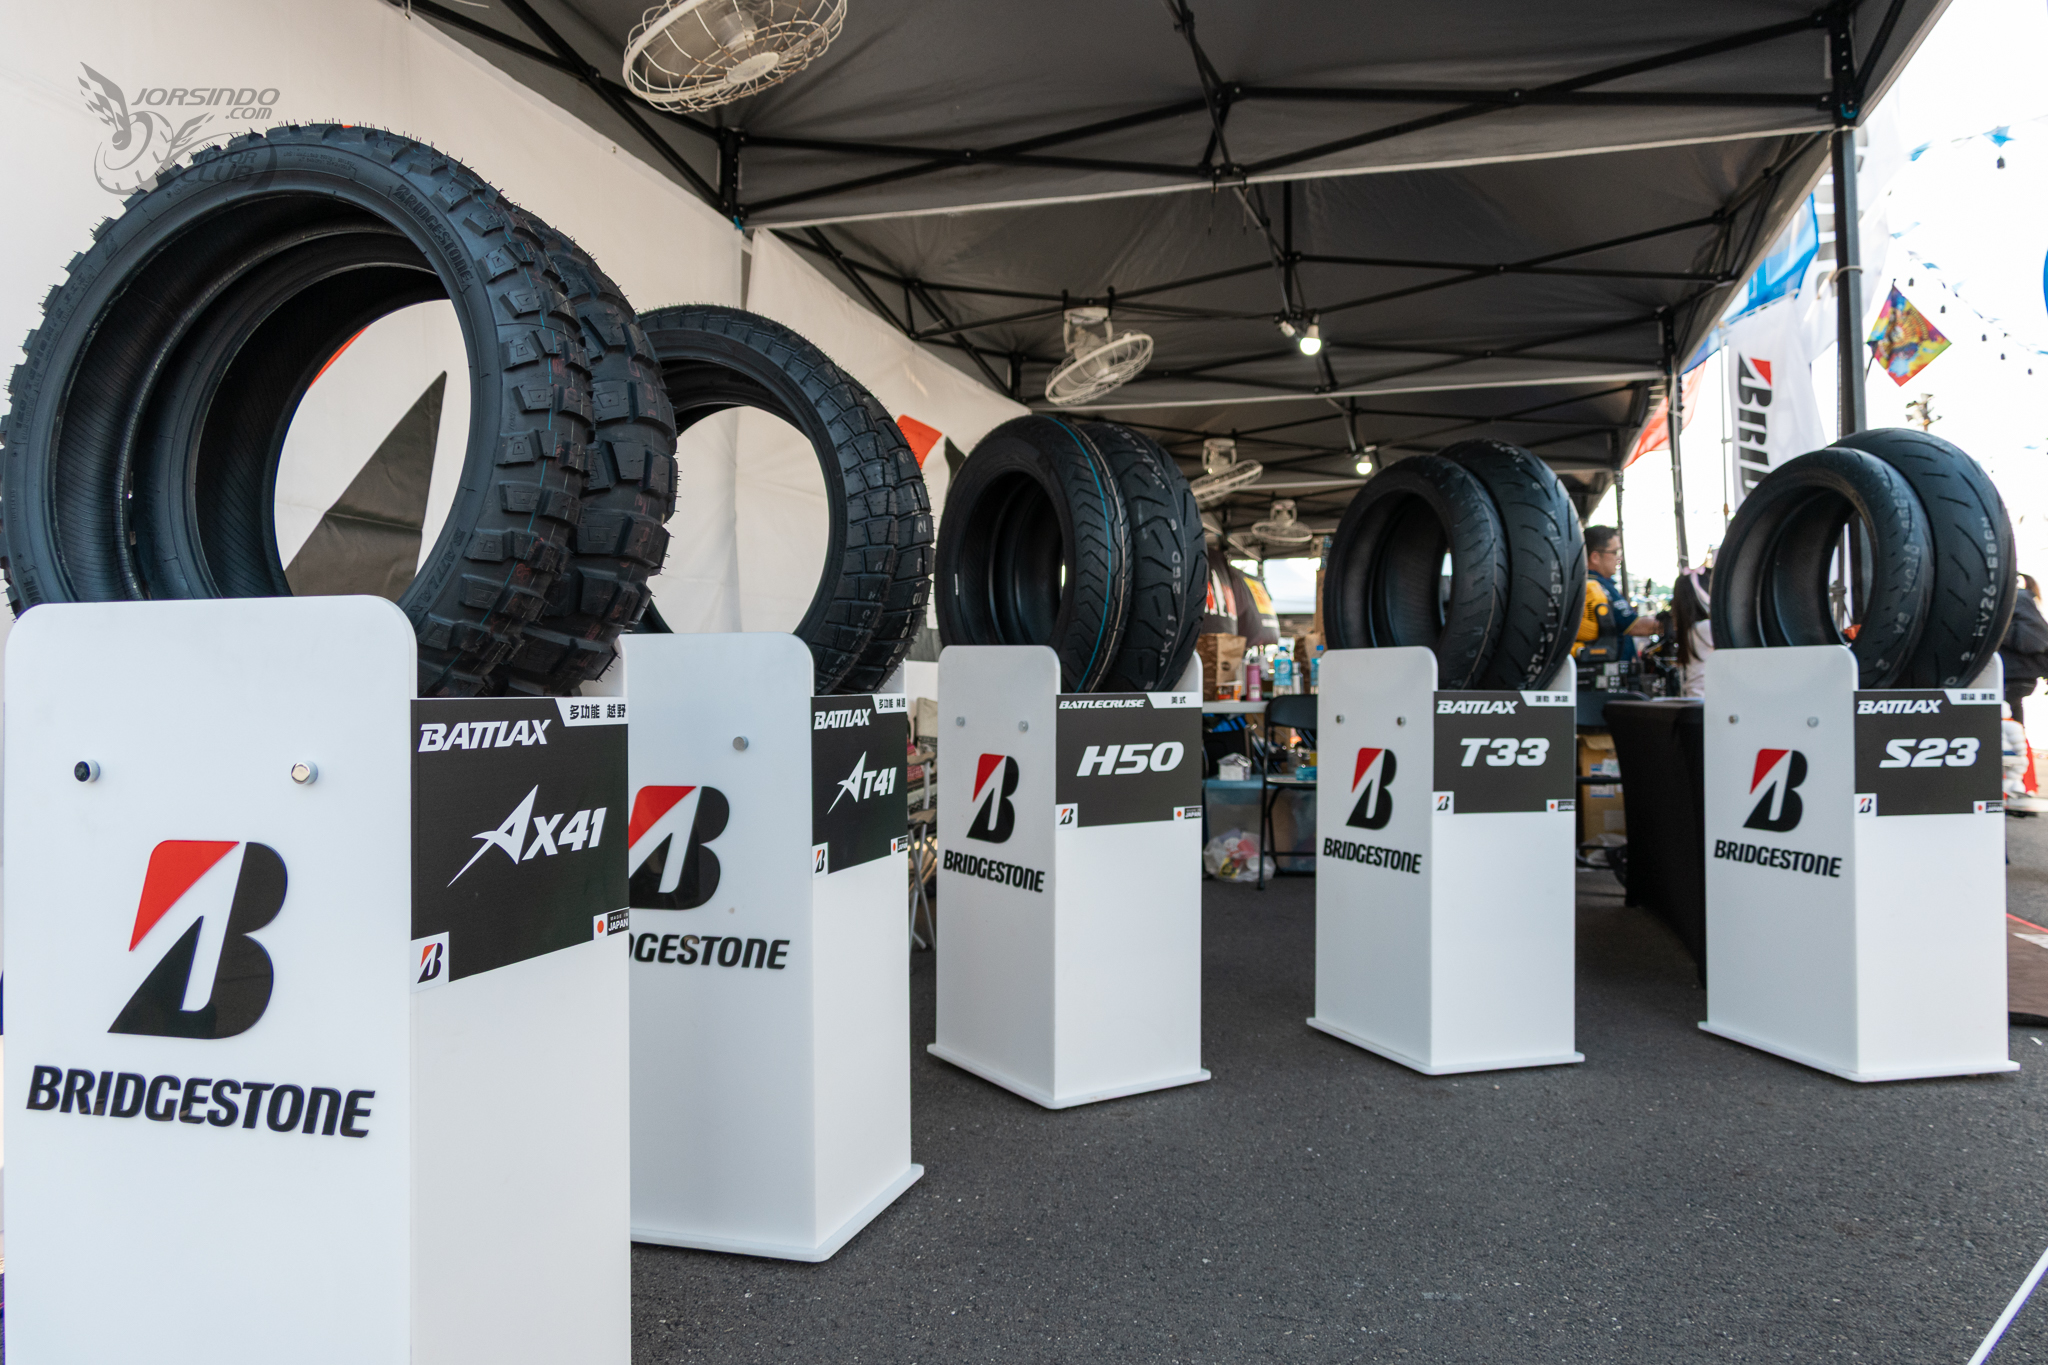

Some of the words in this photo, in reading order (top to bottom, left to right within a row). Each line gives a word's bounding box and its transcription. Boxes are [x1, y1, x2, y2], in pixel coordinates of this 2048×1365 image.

[392, 184, 474, 284] BRIDGESTONE
[569, 704, 601, 720] 多功能
[606, 703, 627, 719] 越野
[813, 708, 872, 730] BATTLAX
[1058, 698, 1146, 710] BATTLECRUISE
[1436, 700, 1518, 715] BATTLAX
[1857, 699, 1943, 715] BATTLAX
[418, 719, 552, 753] BATTLAX
[1460, 737, 1550, 767] T33
[1879, 737, 1980, 769] S23
[1076, 741, 1184, 777] H50
[827, 750, 897, 815] AT41
[446, 784, 607, 888] AX41
[943, 848, 1046, 894] BRIDGESTONE
[1323, 837, 1423, 875] BRIDGESTONE
[1713, 839, 1843, 878] BRIDGESTONE
[608, 918, 629, 932] JAPAN
[26, 1065, 376, 1138] BRIDGESTONE
